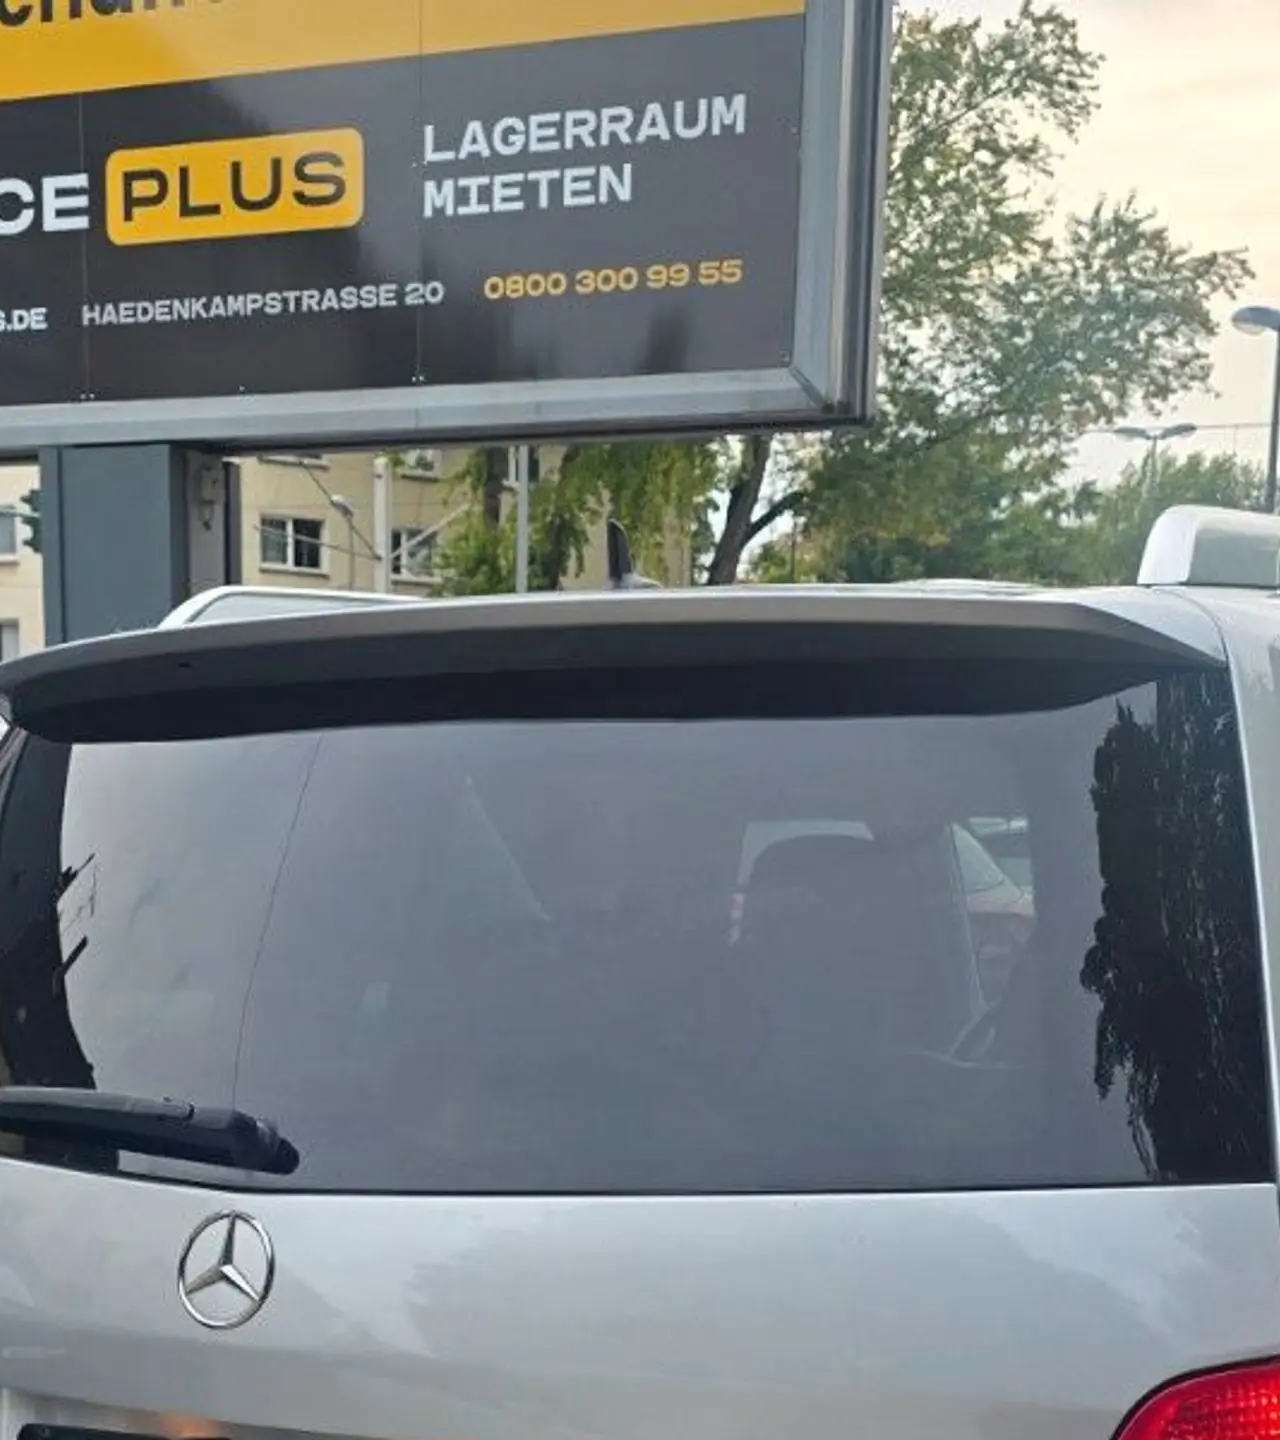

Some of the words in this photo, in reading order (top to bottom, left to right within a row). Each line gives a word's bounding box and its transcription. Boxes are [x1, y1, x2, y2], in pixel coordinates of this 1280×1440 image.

[423, 93, 747, 163] LAGERRAUM
[122, 151, 347, 223] PLUS
[423, 163, 633, 218] MIETEN
[81, 285, 398, 327] HAEDENKAMPSTRASSE
[403, 281, 444, 305] 20
[483, 271, 568, 300] 0800
[575, 267, 639, 294] 300
[646, 263, 692, 287] 99
[698, 259, 743, 284] 55
